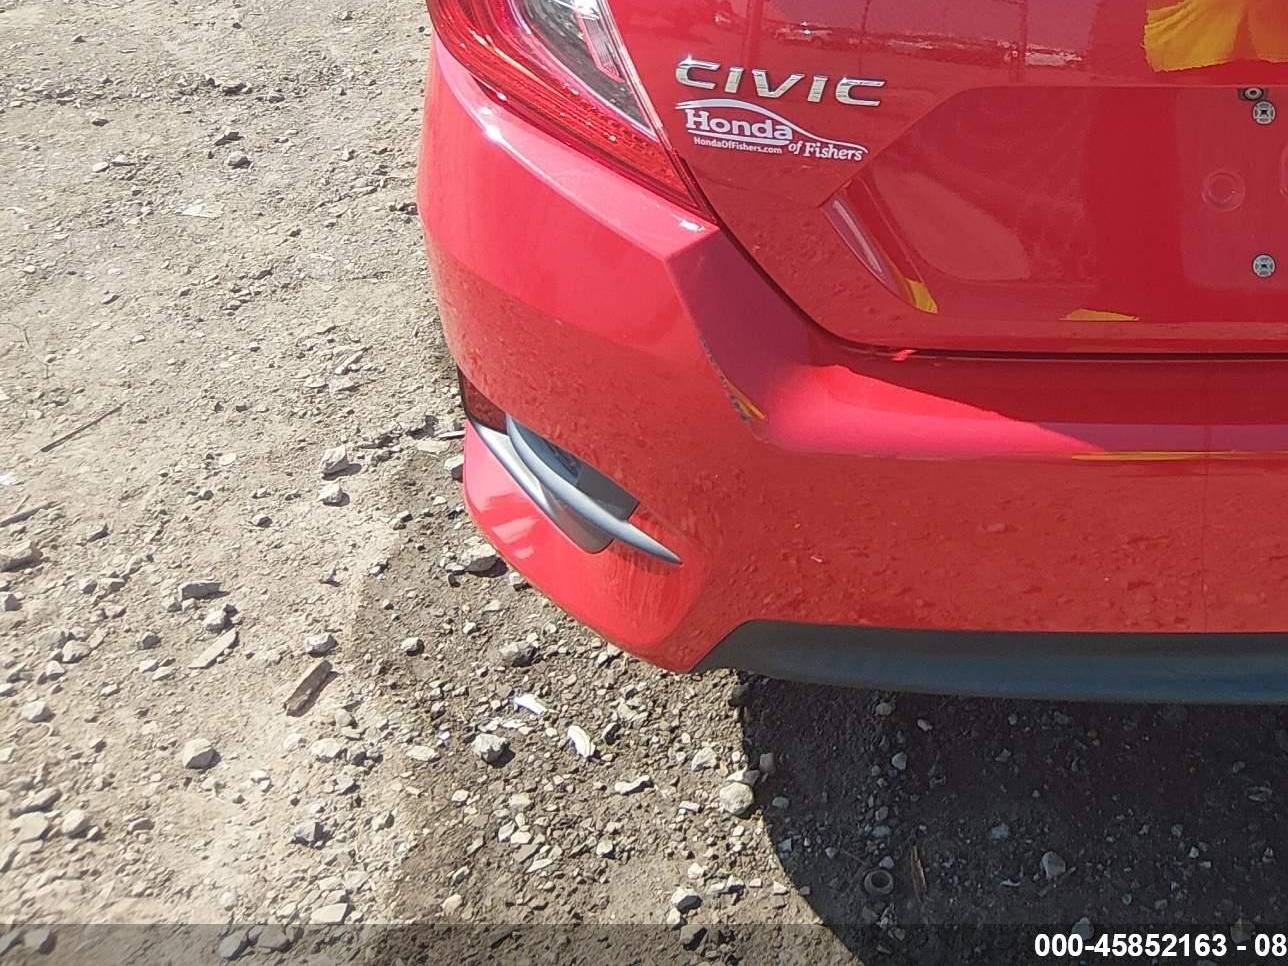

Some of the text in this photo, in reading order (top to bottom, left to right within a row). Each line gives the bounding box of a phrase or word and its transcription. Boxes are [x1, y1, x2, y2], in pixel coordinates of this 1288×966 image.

[675, 57, 886, 107] CIVIC
[685, 108, 793, 140] Honda
[693, 136, 783, 155] HondaOfFishers.com
[788, 141, 864, 162] of Fishers
